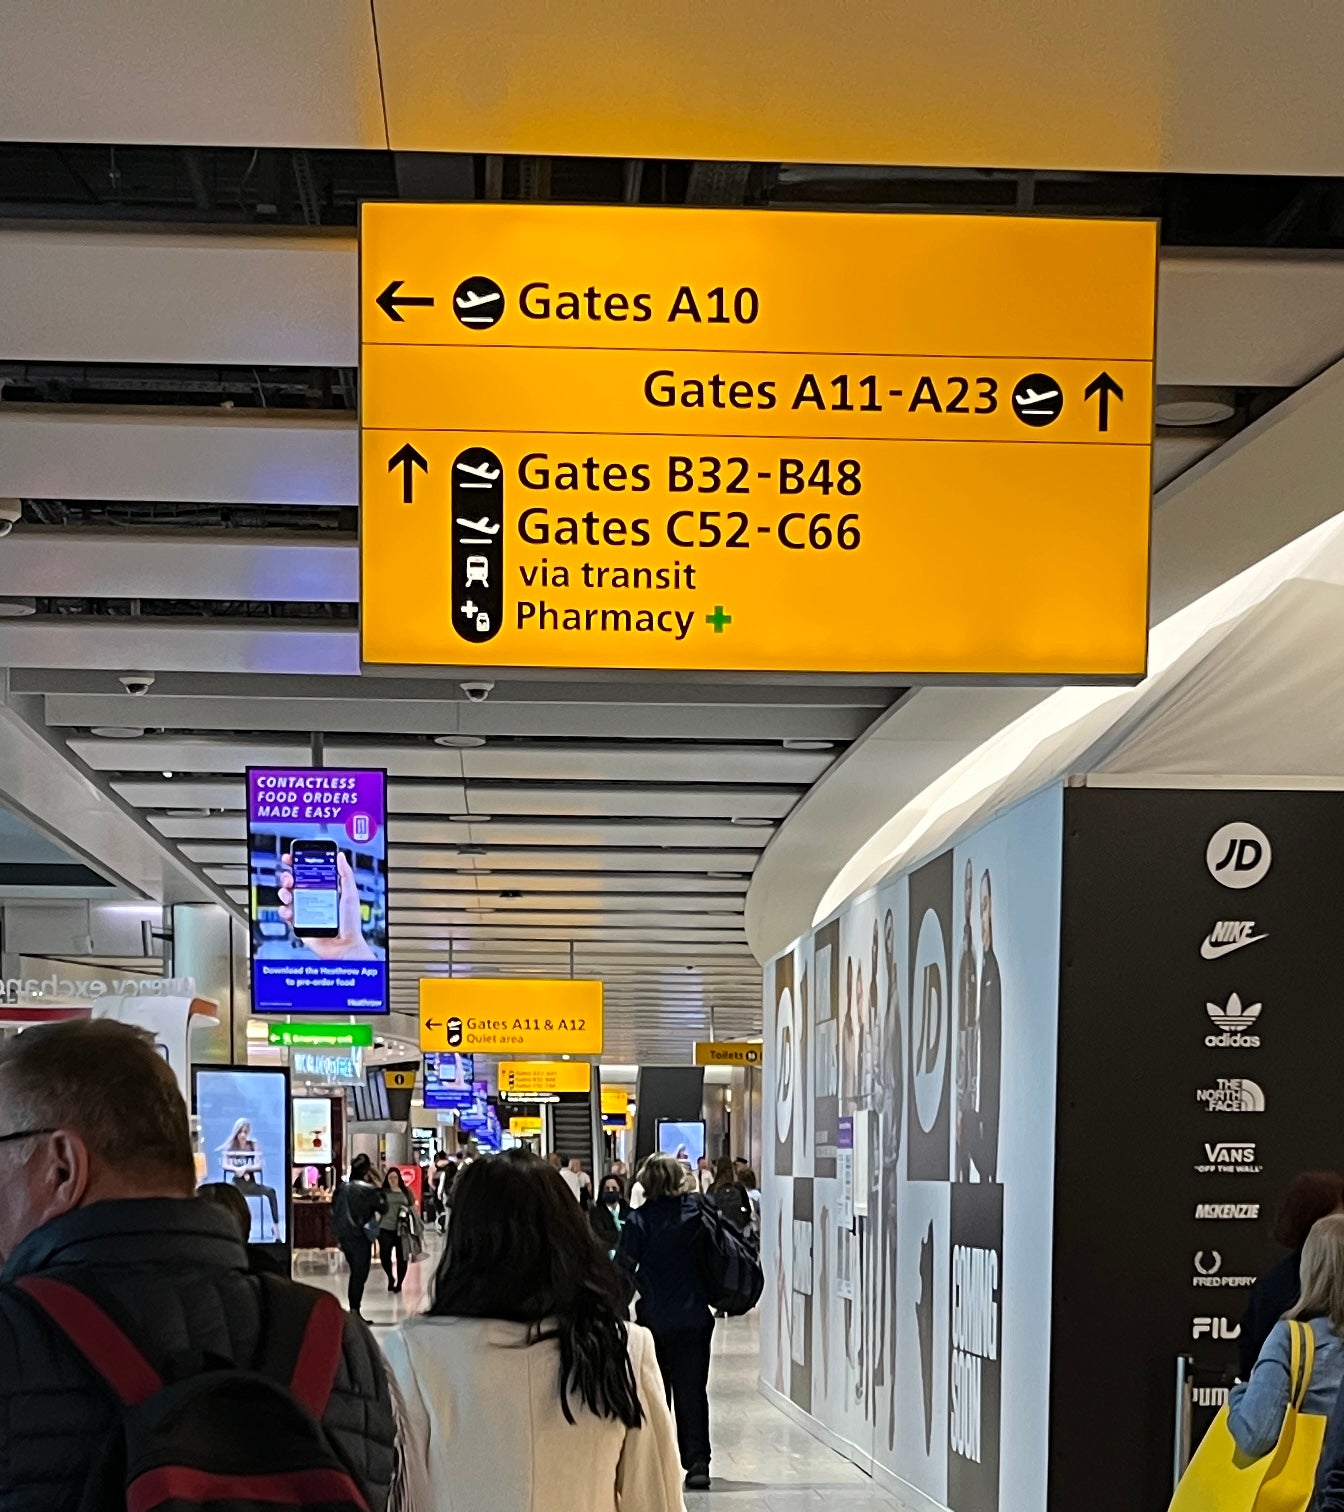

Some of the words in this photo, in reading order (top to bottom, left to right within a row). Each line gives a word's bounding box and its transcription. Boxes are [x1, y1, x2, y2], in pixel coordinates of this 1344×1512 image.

[519, 281, 653, 323] Gates
[667, 287, 760, 325] A10
[643, 369, 777, 411] Gates
[791, 374, 1000, 416] A11-A23
[517, 452, 651, 494] Gates
[667, 456, 863, 497] B32-B48
[517, 508, 651, 549] Gates
[665, 511, 862, 552] C52-C66
[518, 561, 575, 591] via
[582, 560, 697, 592] transit
[516, 601, 695, 641] Pharmacy
[256, 777, 357, 790] CONTACTLESS
[257, 791, 298, 804] FOOD
[302, 792, 358, 804] ORDERS
[257, 806, 299, 818] MADE
[304, 806, 342, 819] EASY
[1214, 839, 1262, 872] JD
[1210, 921, 1256, 943] NIKE
[361, 967, 378, 977] App
[336, 978, 356, 987] food
[466, 1018, 508, 1031] Gates
[512, 1019, 540, 1031] A11
[543, 1019, 554, 1031] &
[557, 1019, 586, 1032] A12
[466, 1033, 497, 1044] Quiet
[499, 1034, 524, 1044] area
[1204, 1032, 1262, 1048] adidas
[710, 1050, 744, 1060] Toilets
[1216, 1078, 1241, 1090] THE
[1196, 1089, 1241, 1101] NORTH
[1209, 1100, 1241, 1112] FACE
[1204, 1143, 1256, 1163] VANS
[1192, 1276, 1222, 1287] FRED
[1222, 1276, 1258, 1287] PERRY
